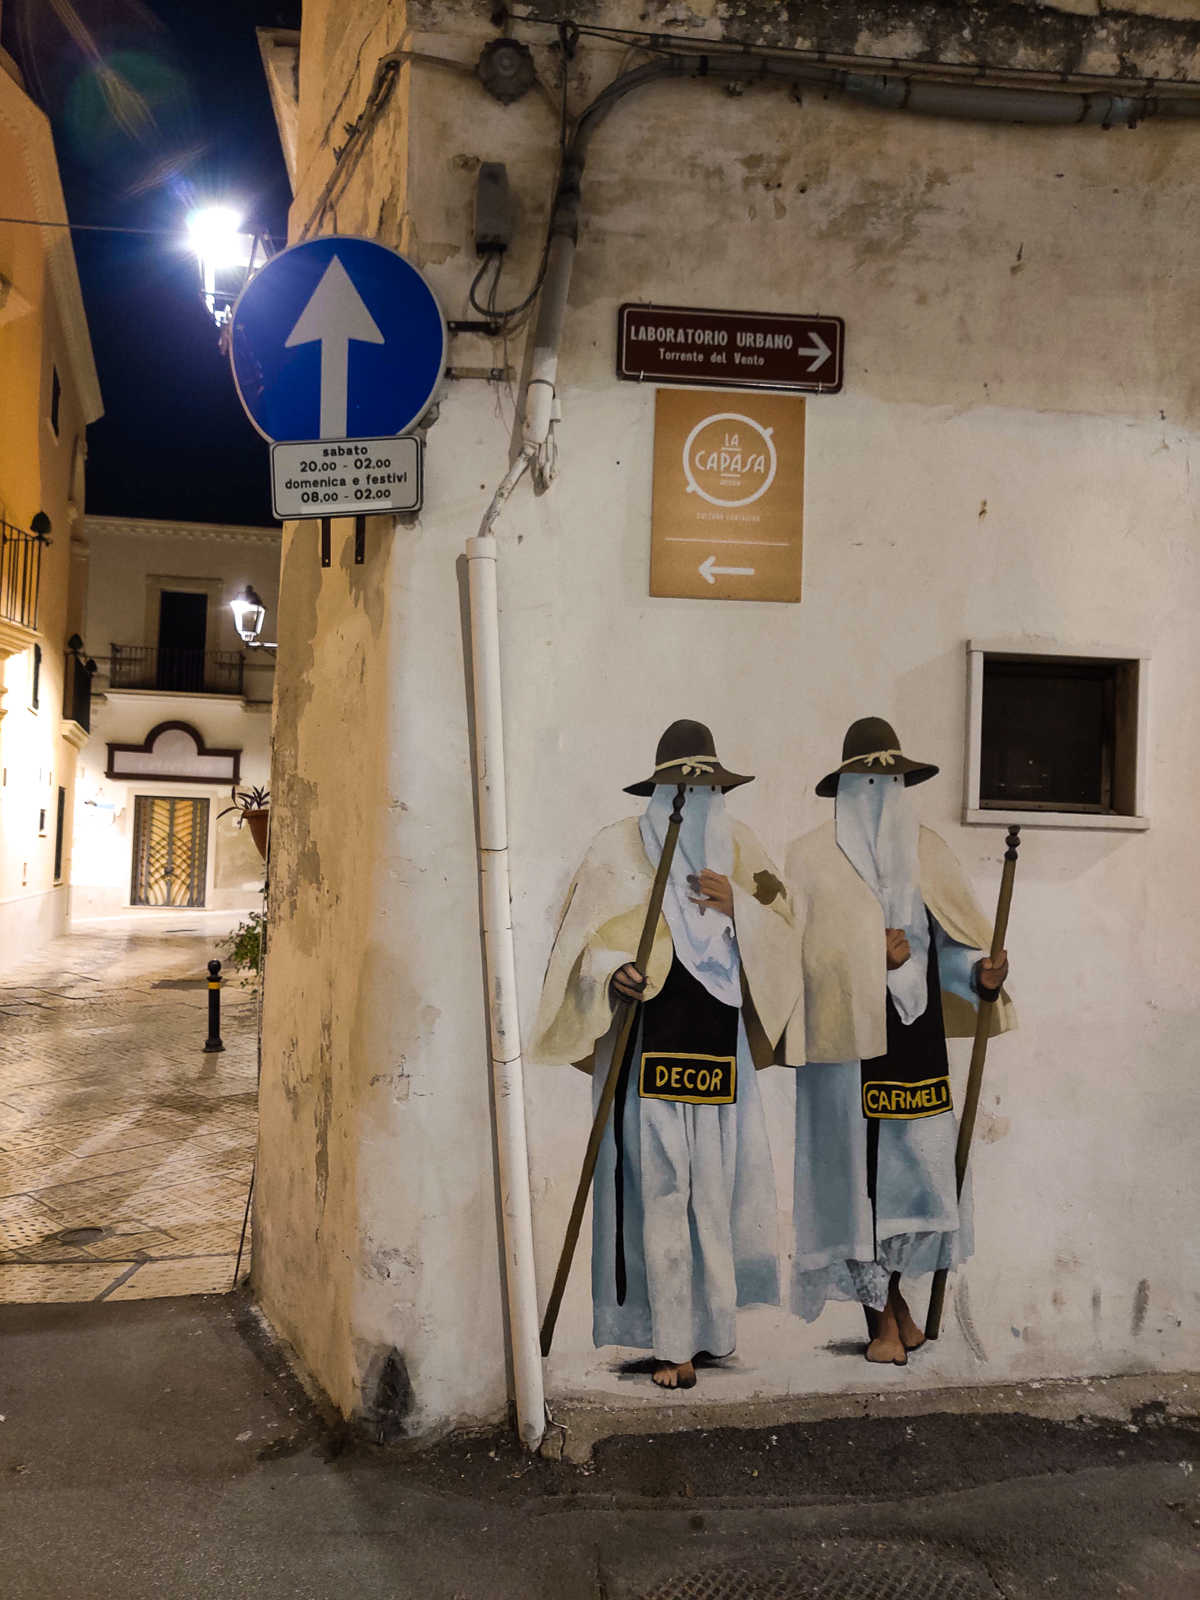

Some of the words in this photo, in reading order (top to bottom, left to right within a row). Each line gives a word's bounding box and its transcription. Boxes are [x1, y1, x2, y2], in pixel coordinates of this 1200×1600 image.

[630, 325, 728, 346] LABORATORIO
[736, 332, 793, 350] URBANO
[659, 348, 704, 362] Torrente
[710, 352, 727, 364] del
[734, 352, 765, 366] Vento
[725, 433, 739, 447] LA
[322, 445, 368, 457] sabato
[300, 461, 337, 473] 20.00
[354, 458, 391, 470] 02.00
[695, 450, 765, 474] CAPASA
[285, 477, 346, 489] domenica
[352, 476, 360, 485] e
[366, 472, 407, 485] festivi
[301, 491, 338, 503] 08.00
[354, 489, 391, 500] 02.00
[655, 1065, 723, 1092] DECOR
[866, 1086, 947, 1111] CARMELI
